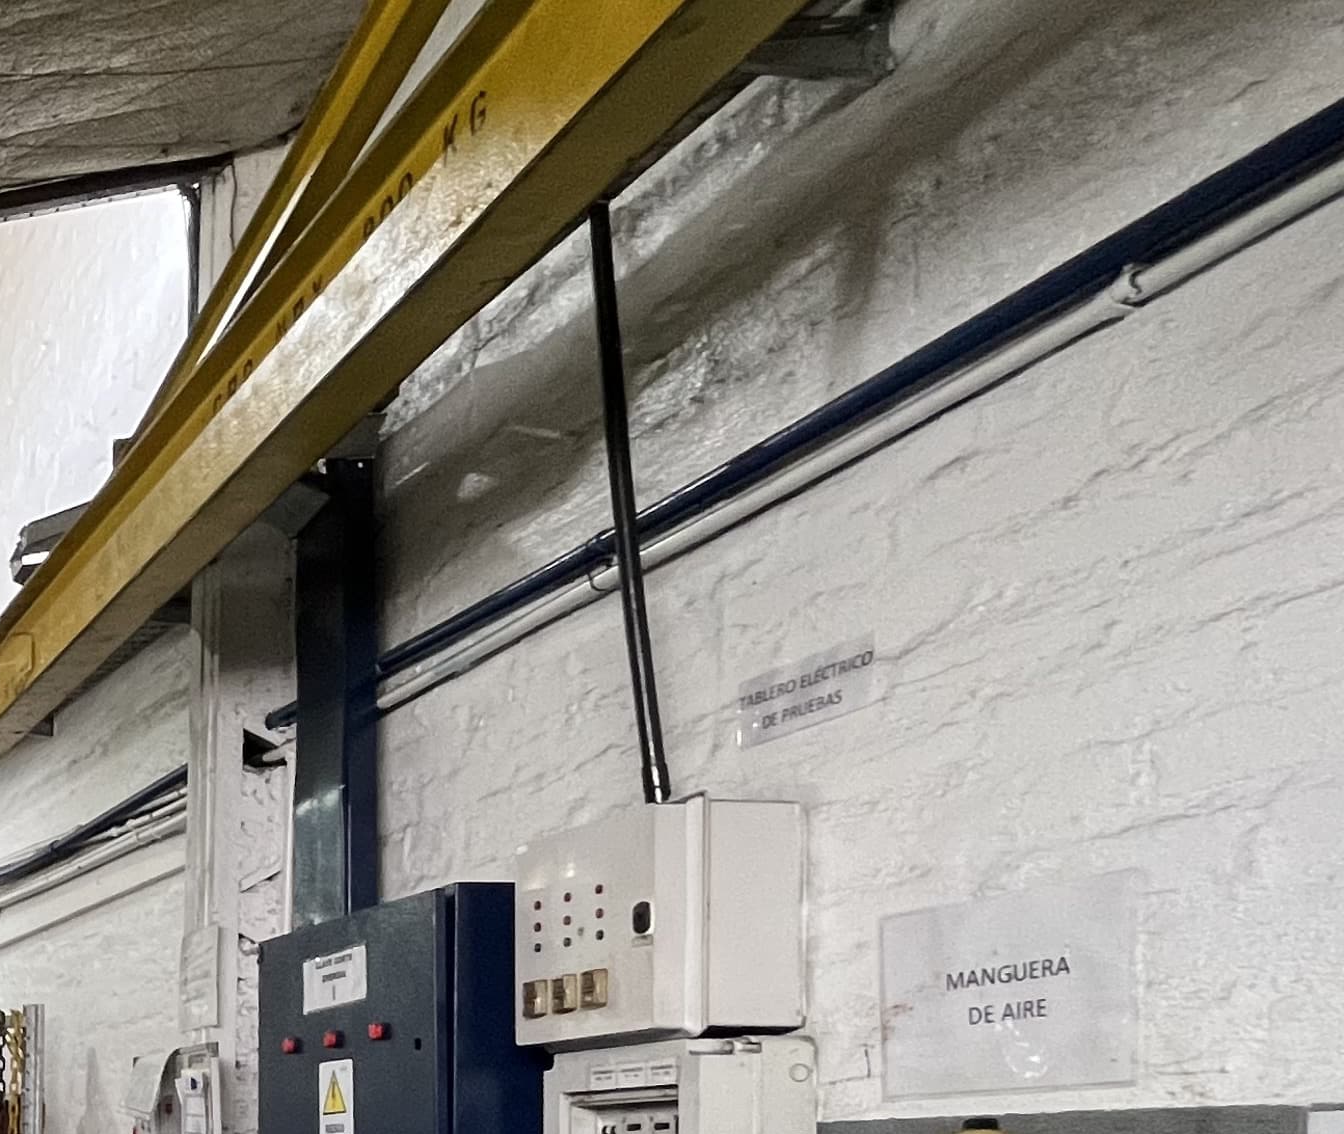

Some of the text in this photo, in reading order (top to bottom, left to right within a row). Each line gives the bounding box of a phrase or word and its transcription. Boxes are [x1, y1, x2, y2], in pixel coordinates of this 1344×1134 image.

[739, 679, 797, 711] TABLERO
[762, 689, 843, 730] DE PRUEBAS
[945, 956, 1070, 991] MANGUERA
[968, 998, 1047, 1026] DE AIRE
